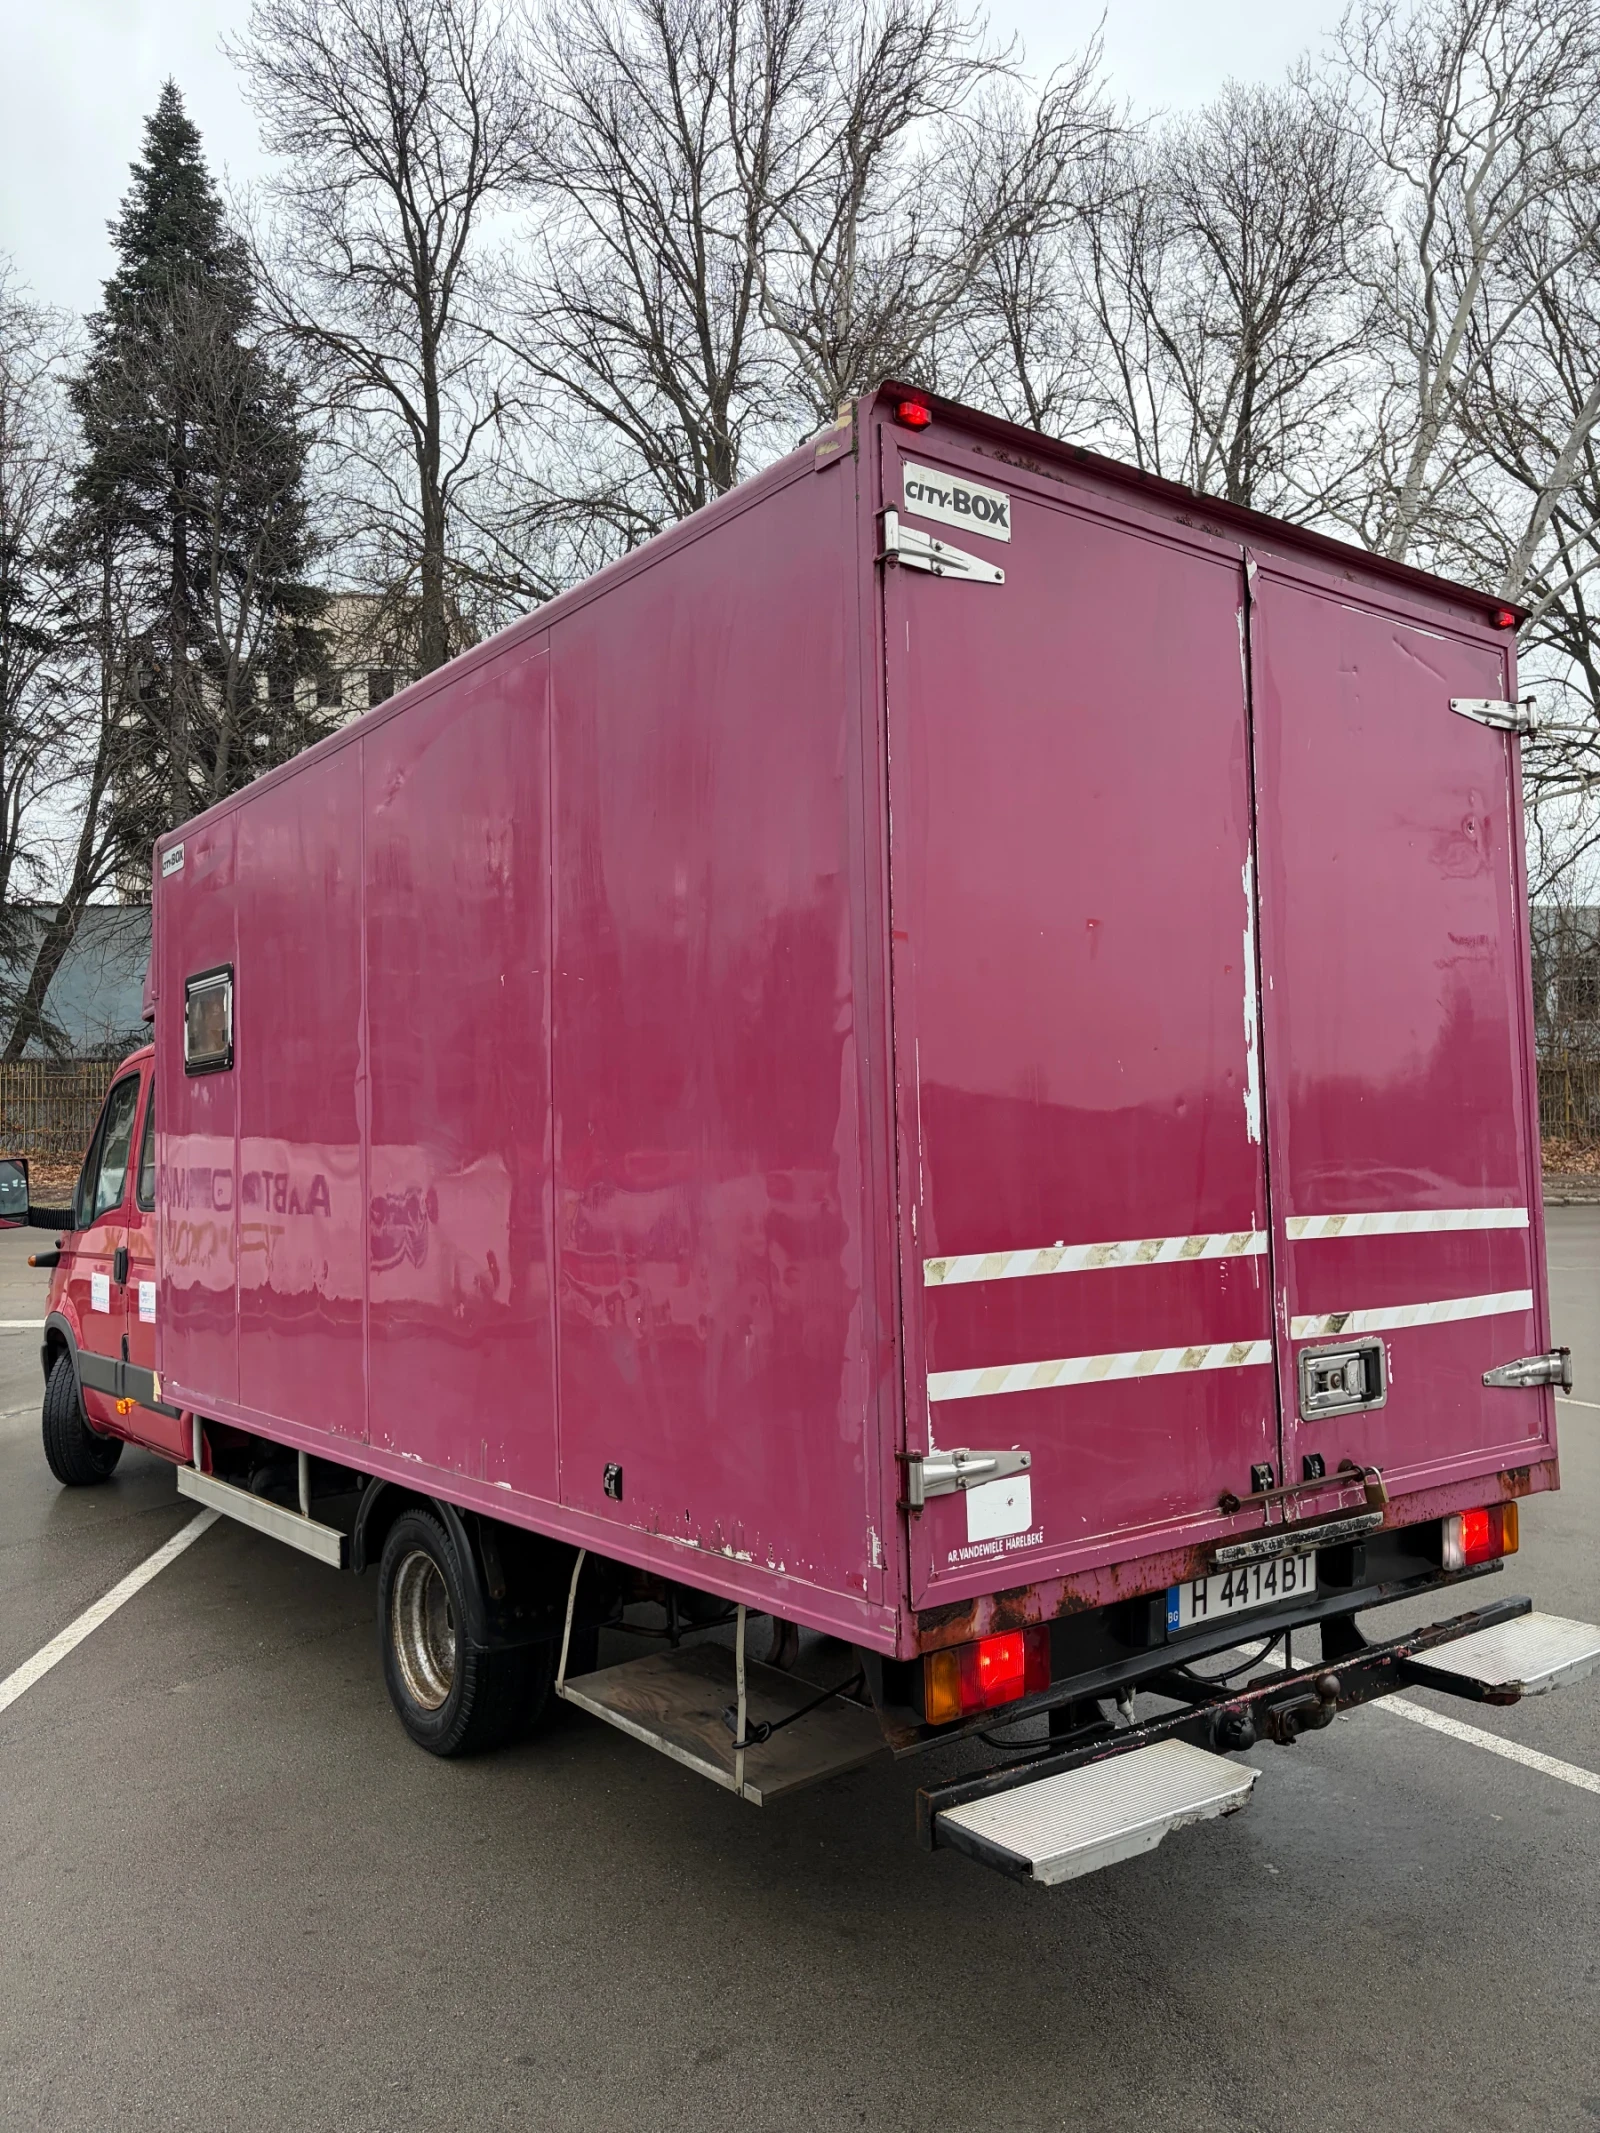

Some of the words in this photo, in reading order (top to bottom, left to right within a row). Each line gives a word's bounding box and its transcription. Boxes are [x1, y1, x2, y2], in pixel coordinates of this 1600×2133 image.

[905, 480, 1009, 529] CITY-BOX
[1005, 1531, 1044, 1551] HARELBEKE
[1167, 1610, 1179, 1624] BG
